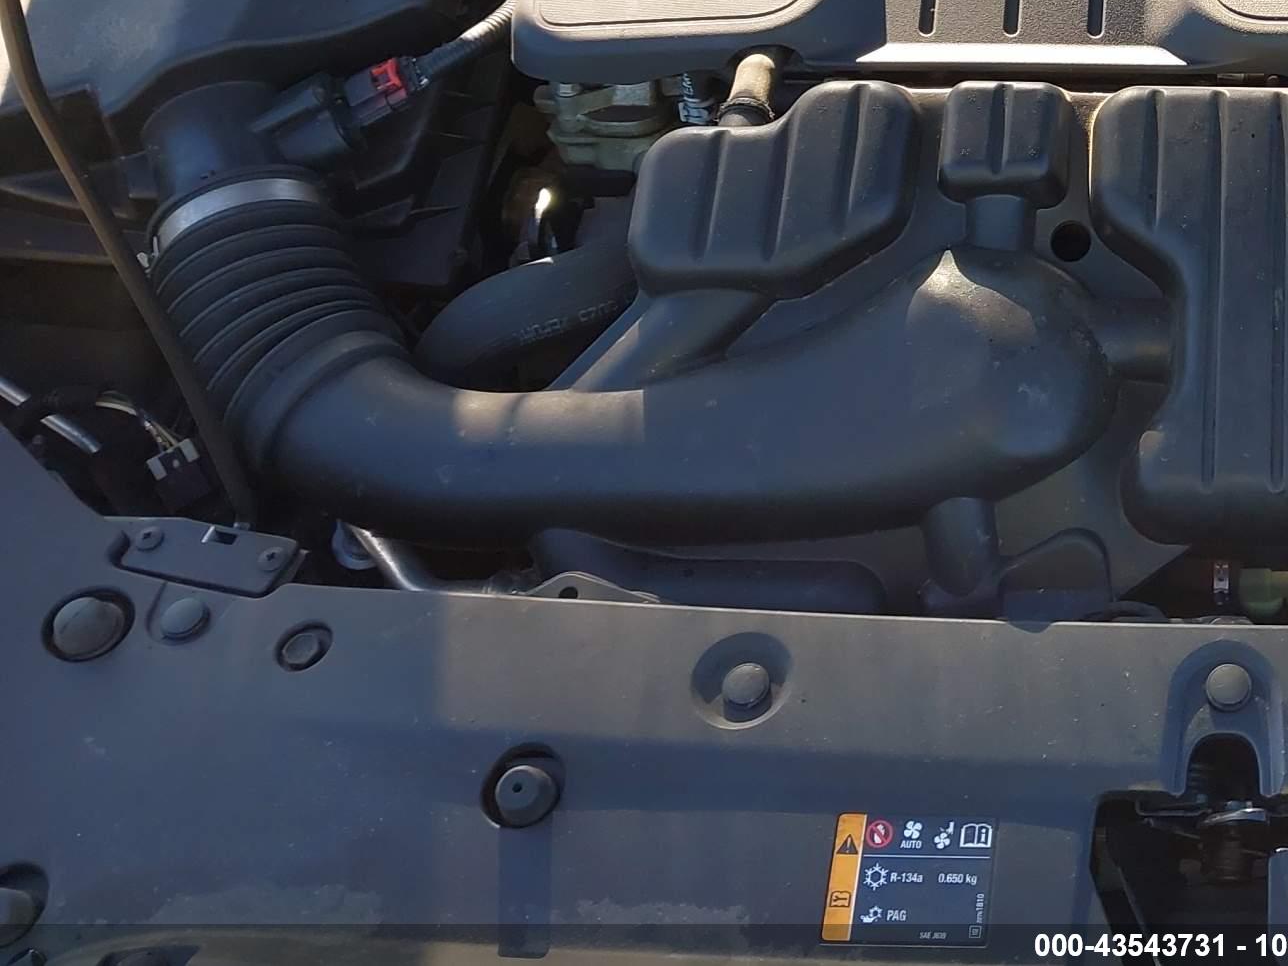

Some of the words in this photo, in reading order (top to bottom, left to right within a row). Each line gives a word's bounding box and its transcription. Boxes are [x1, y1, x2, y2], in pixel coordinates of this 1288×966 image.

[900, 840, 922, 849] AUTO
[890, 873, 923, 883] R-134a
[938, 873, 964, 883] 0.650
[965, 873, 978, 886] kg
[886, 909, 907, 921] PAG
